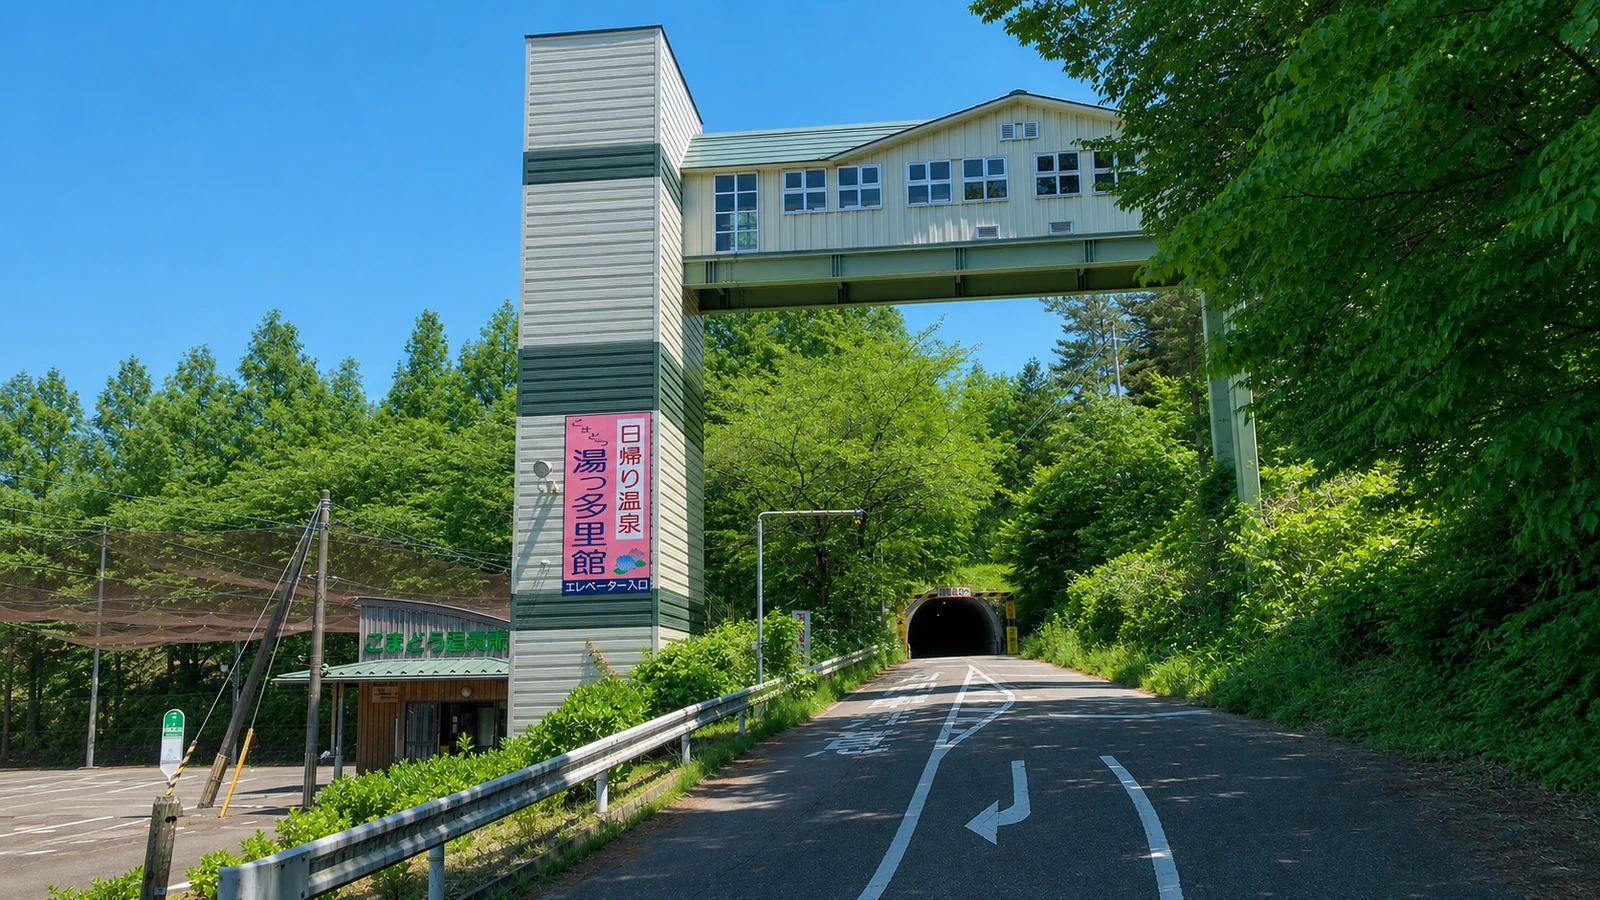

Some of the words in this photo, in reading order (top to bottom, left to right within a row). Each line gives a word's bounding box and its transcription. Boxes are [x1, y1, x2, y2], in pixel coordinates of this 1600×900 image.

[618, 424, 642, 534] 日帰り温泉
[565, 579, 648, 593] エレベーター入口
